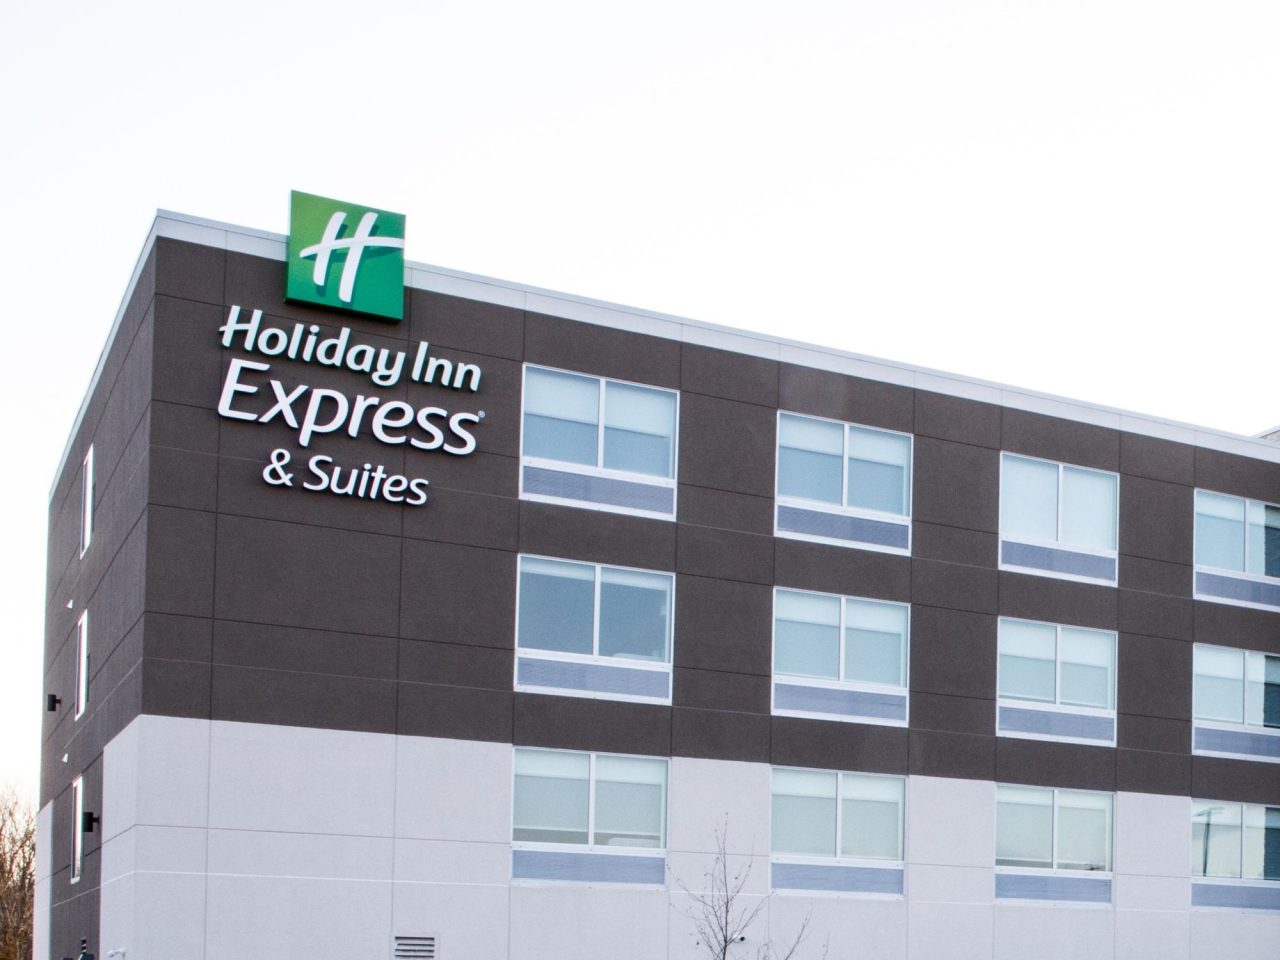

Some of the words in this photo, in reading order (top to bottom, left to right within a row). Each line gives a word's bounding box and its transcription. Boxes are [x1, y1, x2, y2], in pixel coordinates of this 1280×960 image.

[219, 305, 406, 386] Holiday
[411, 341, 481, 391] Inn
[217, 358, 479, 455] Express
[263, 448, 293, 486] &
[303, 455, 429, 505] Suites
